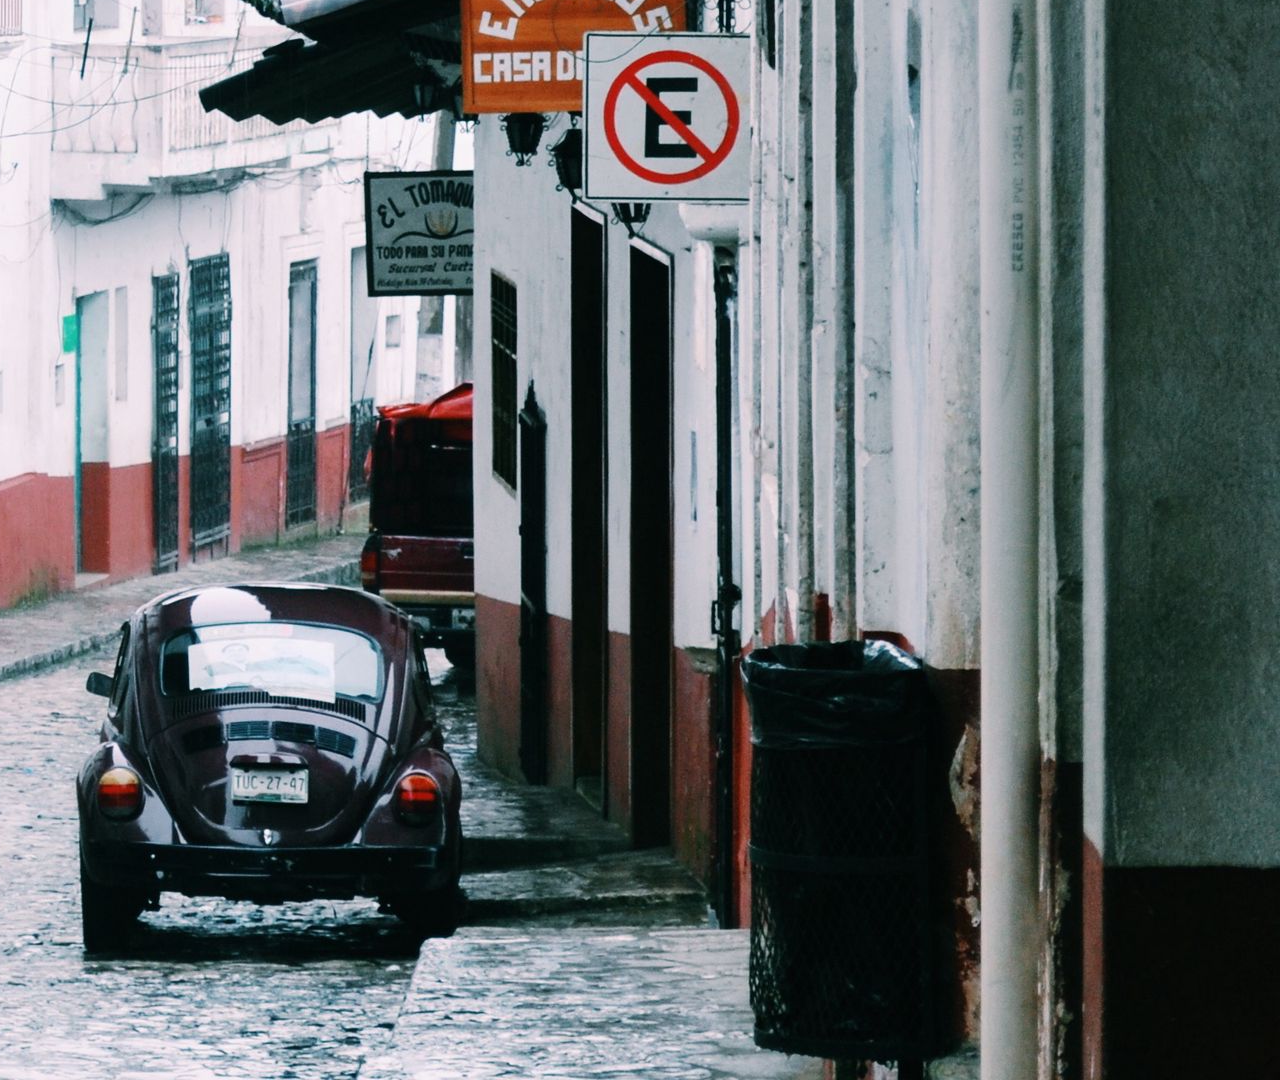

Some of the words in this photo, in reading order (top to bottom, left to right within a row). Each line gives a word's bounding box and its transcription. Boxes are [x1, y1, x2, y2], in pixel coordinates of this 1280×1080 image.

[473, 50, 551, 83] CASA
[645, 77, 699, 159] E
[376, 246, 403, 260] TODO
[405, 245, 428, 259] PARA
[431, 244, 445, 258] SU
[388, 262, 438, 274] Sucursal
[235, 775, 305, 792] TUC-27-47
